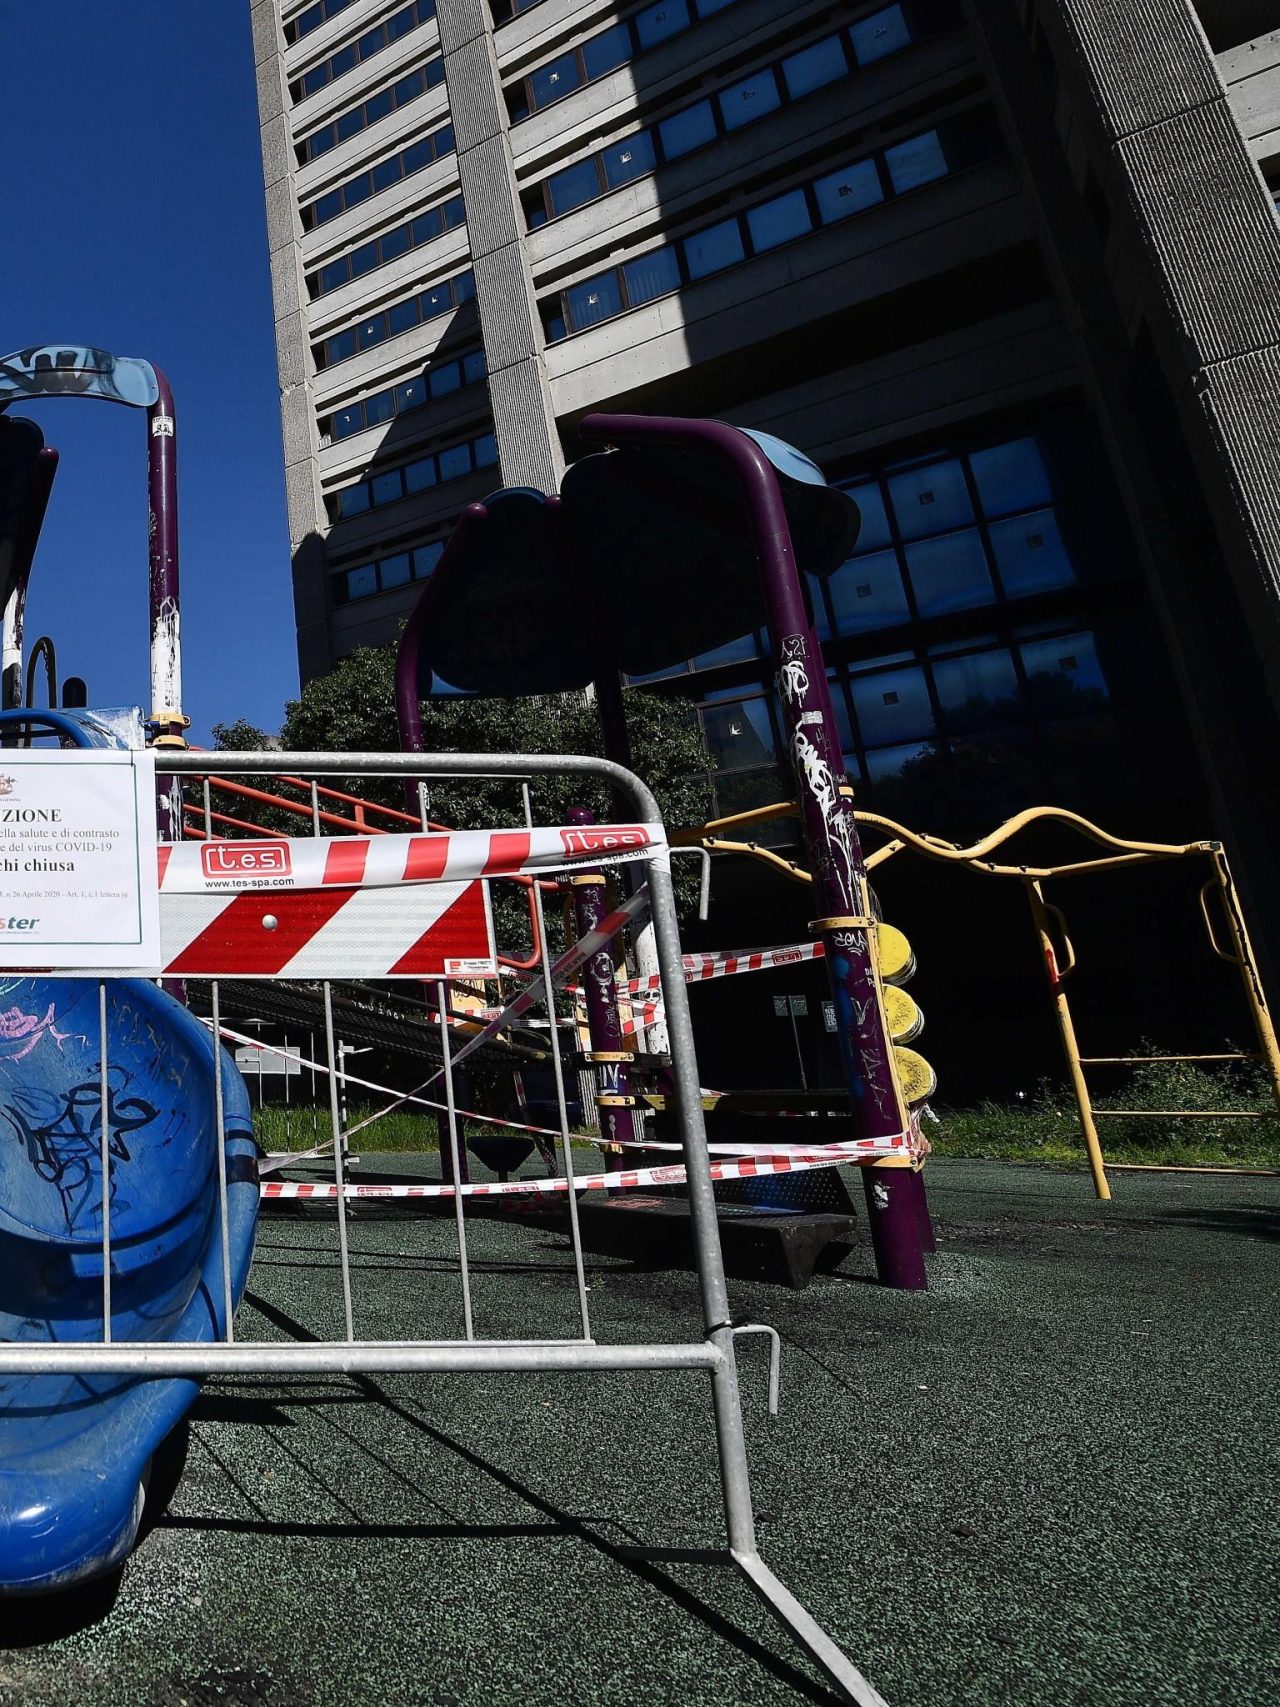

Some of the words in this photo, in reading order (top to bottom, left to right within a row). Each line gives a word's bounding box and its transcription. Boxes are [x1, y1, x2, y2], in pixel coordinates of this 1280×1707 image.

[19, 827, 49, 839] salute
[52, 830, 58, 838] e
[60, 827, 70, 839] di
[73, 828, 119, 839] contrasto
[9, 841, 24, 853] del
[28, 841, 53, 853] virus
[56, 841, 113, 853] COVID-19
[217, 846, 280, 868] t.e.s.
[24, 857, 76, 872] chiusa
[205, 878, 295, 888] www.tes-spa.com
[22, 889, 43, 899] Aprile
[44, 890, 61, 898] 2020
